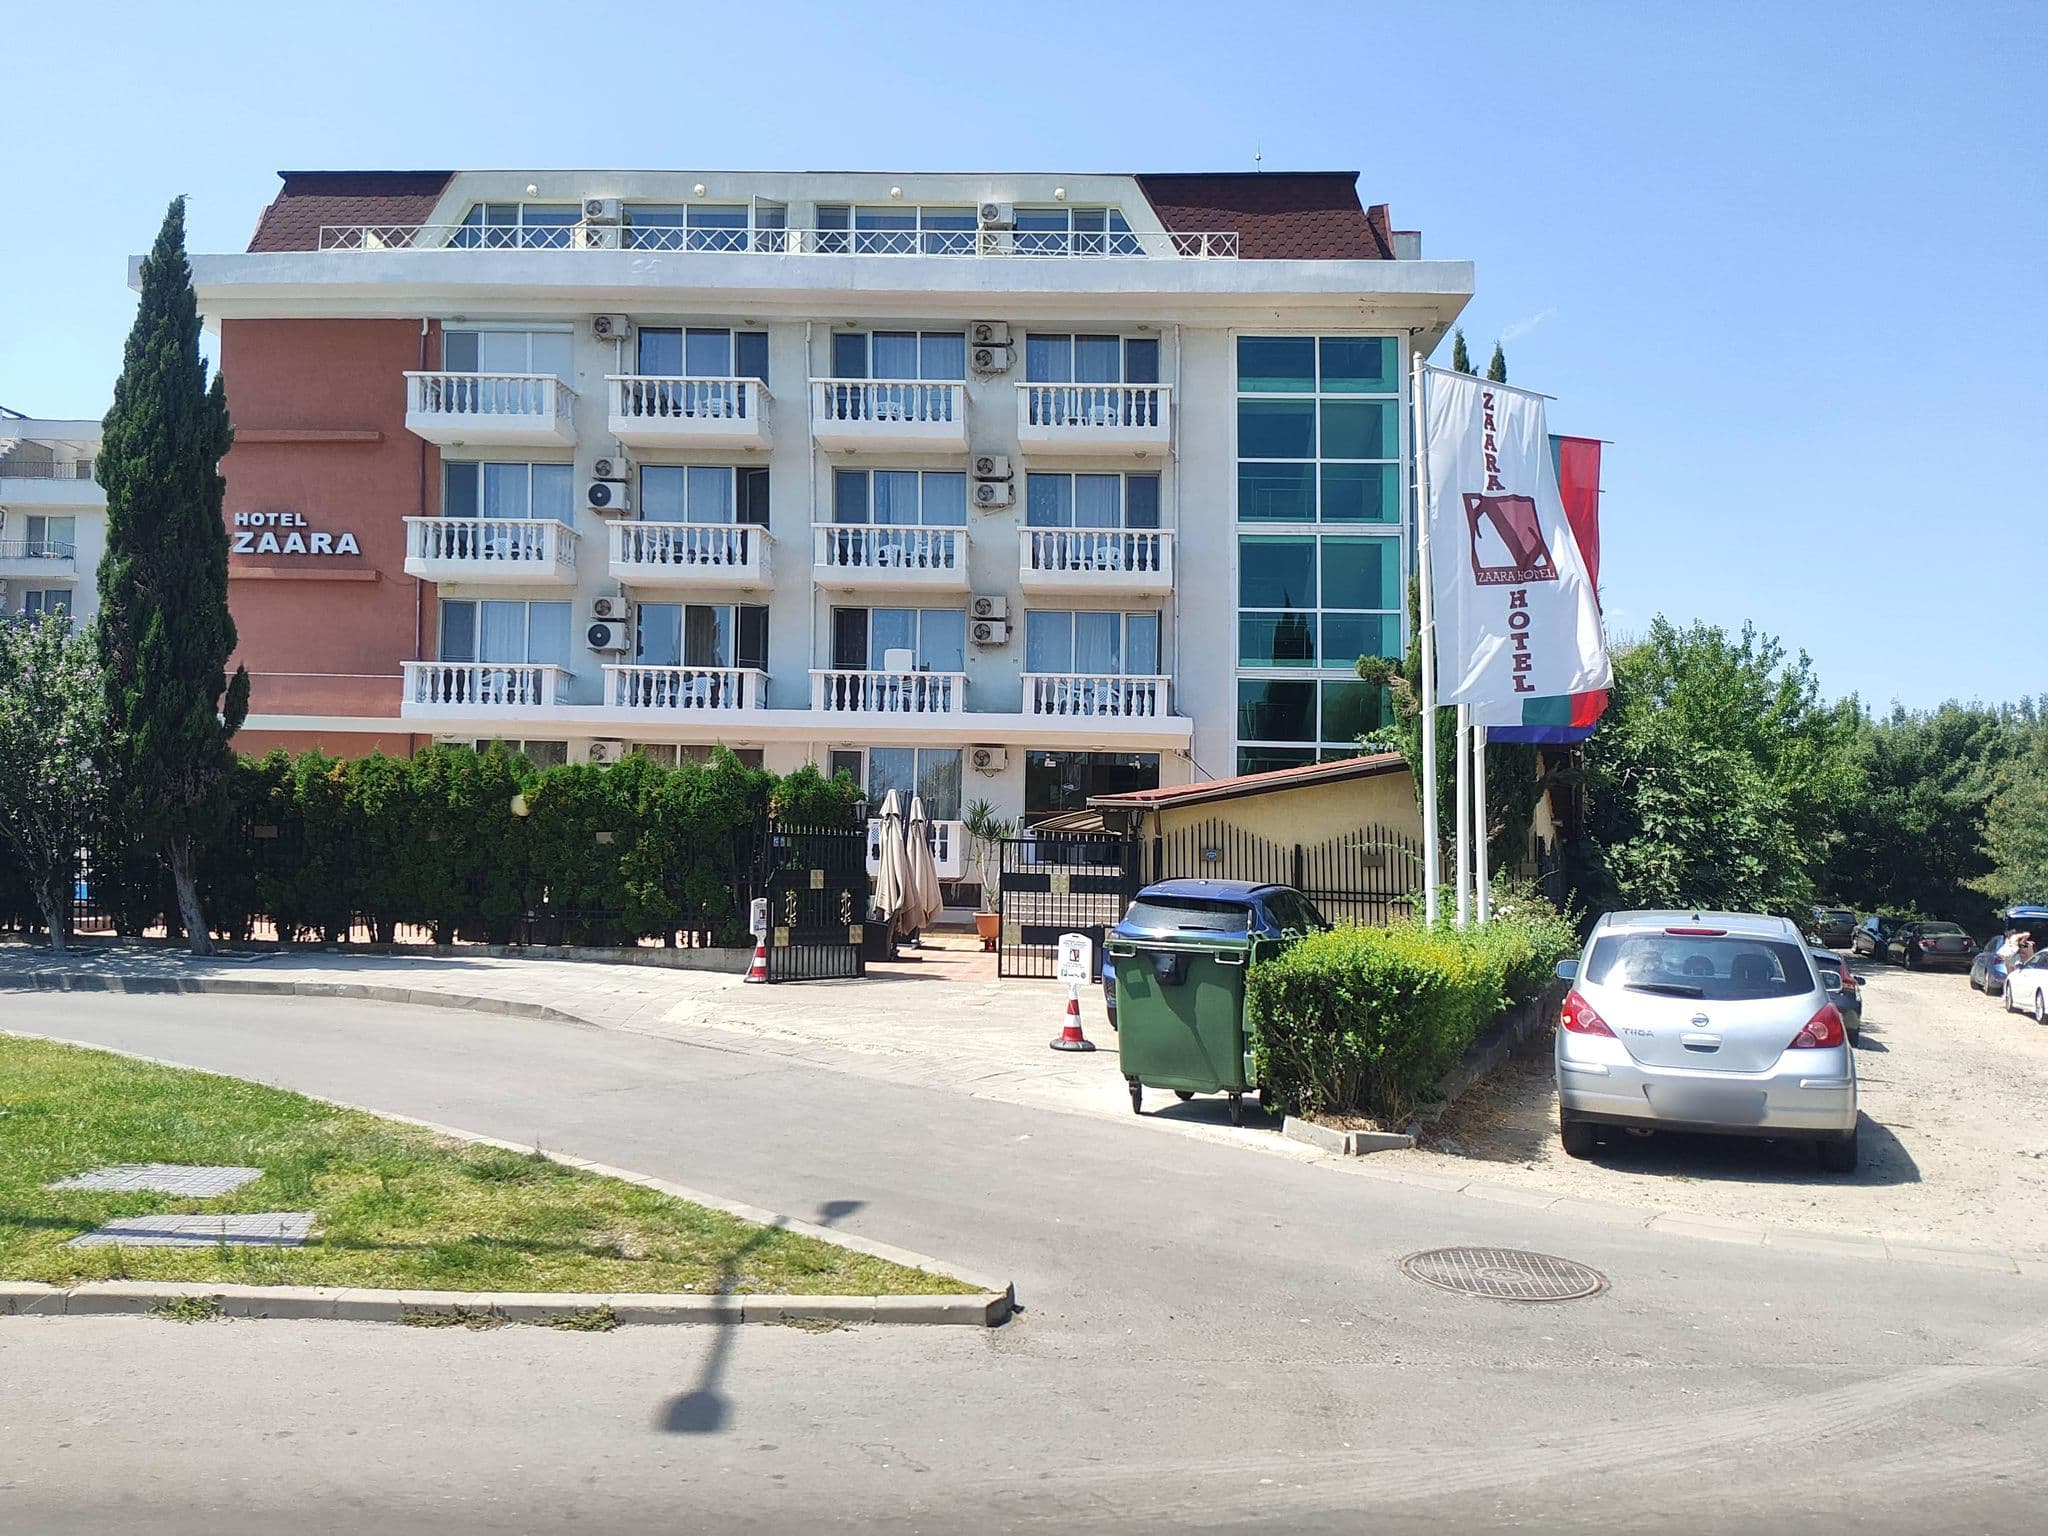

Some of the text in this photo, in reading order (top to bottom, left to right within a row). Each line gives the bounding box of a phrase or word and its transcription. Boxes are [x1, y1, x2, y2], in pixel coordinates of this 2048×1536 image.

[1482, 391, 1506, 491] ZAARA
[234, 512, 307, 527] HOTEL
[232, 531, 360, 555] ZAARA
[1477, 568, 1555, 583] ZAARA HOTEL
[1507, 590, 1535, 693] HOTEL
